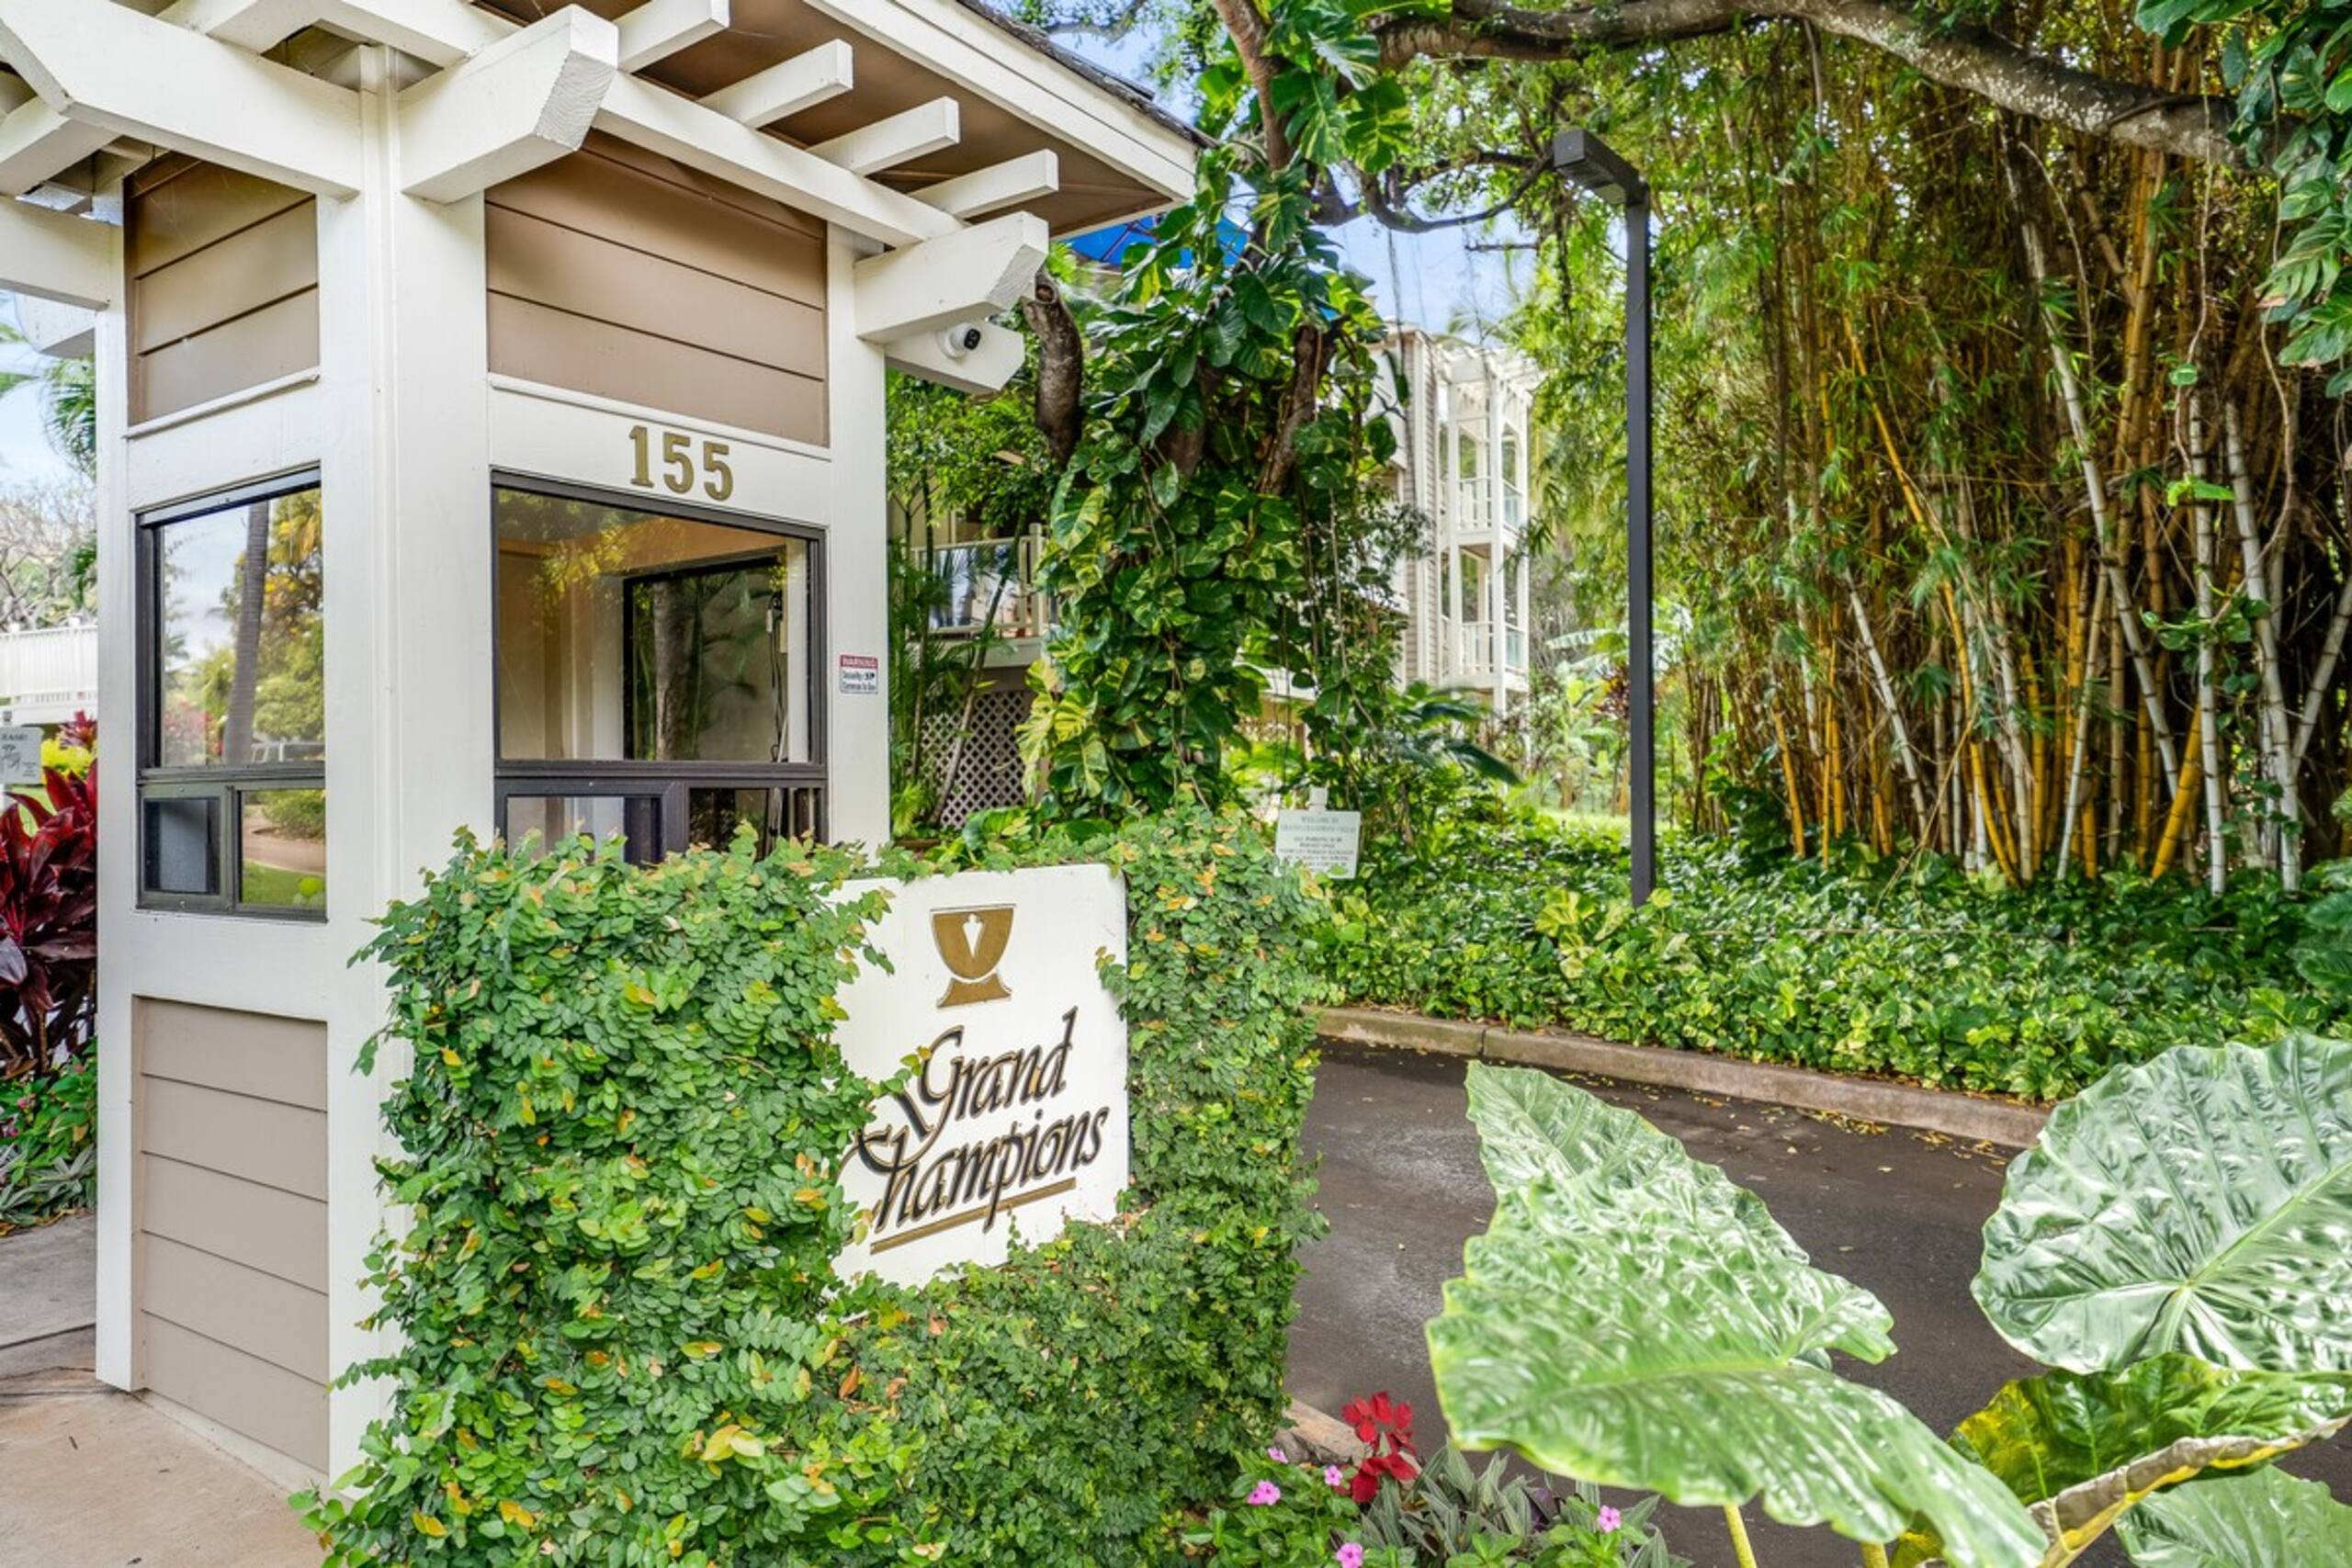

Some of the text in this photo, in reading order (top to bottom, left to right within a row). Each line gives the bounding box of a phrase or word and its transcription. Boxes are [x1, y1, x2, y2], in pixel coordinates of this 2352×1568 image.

[628, 424, 734, 502] 155
[917, 1005, 1079, 1124] Grand
[854, 1105, 1110, 1234] Champions
